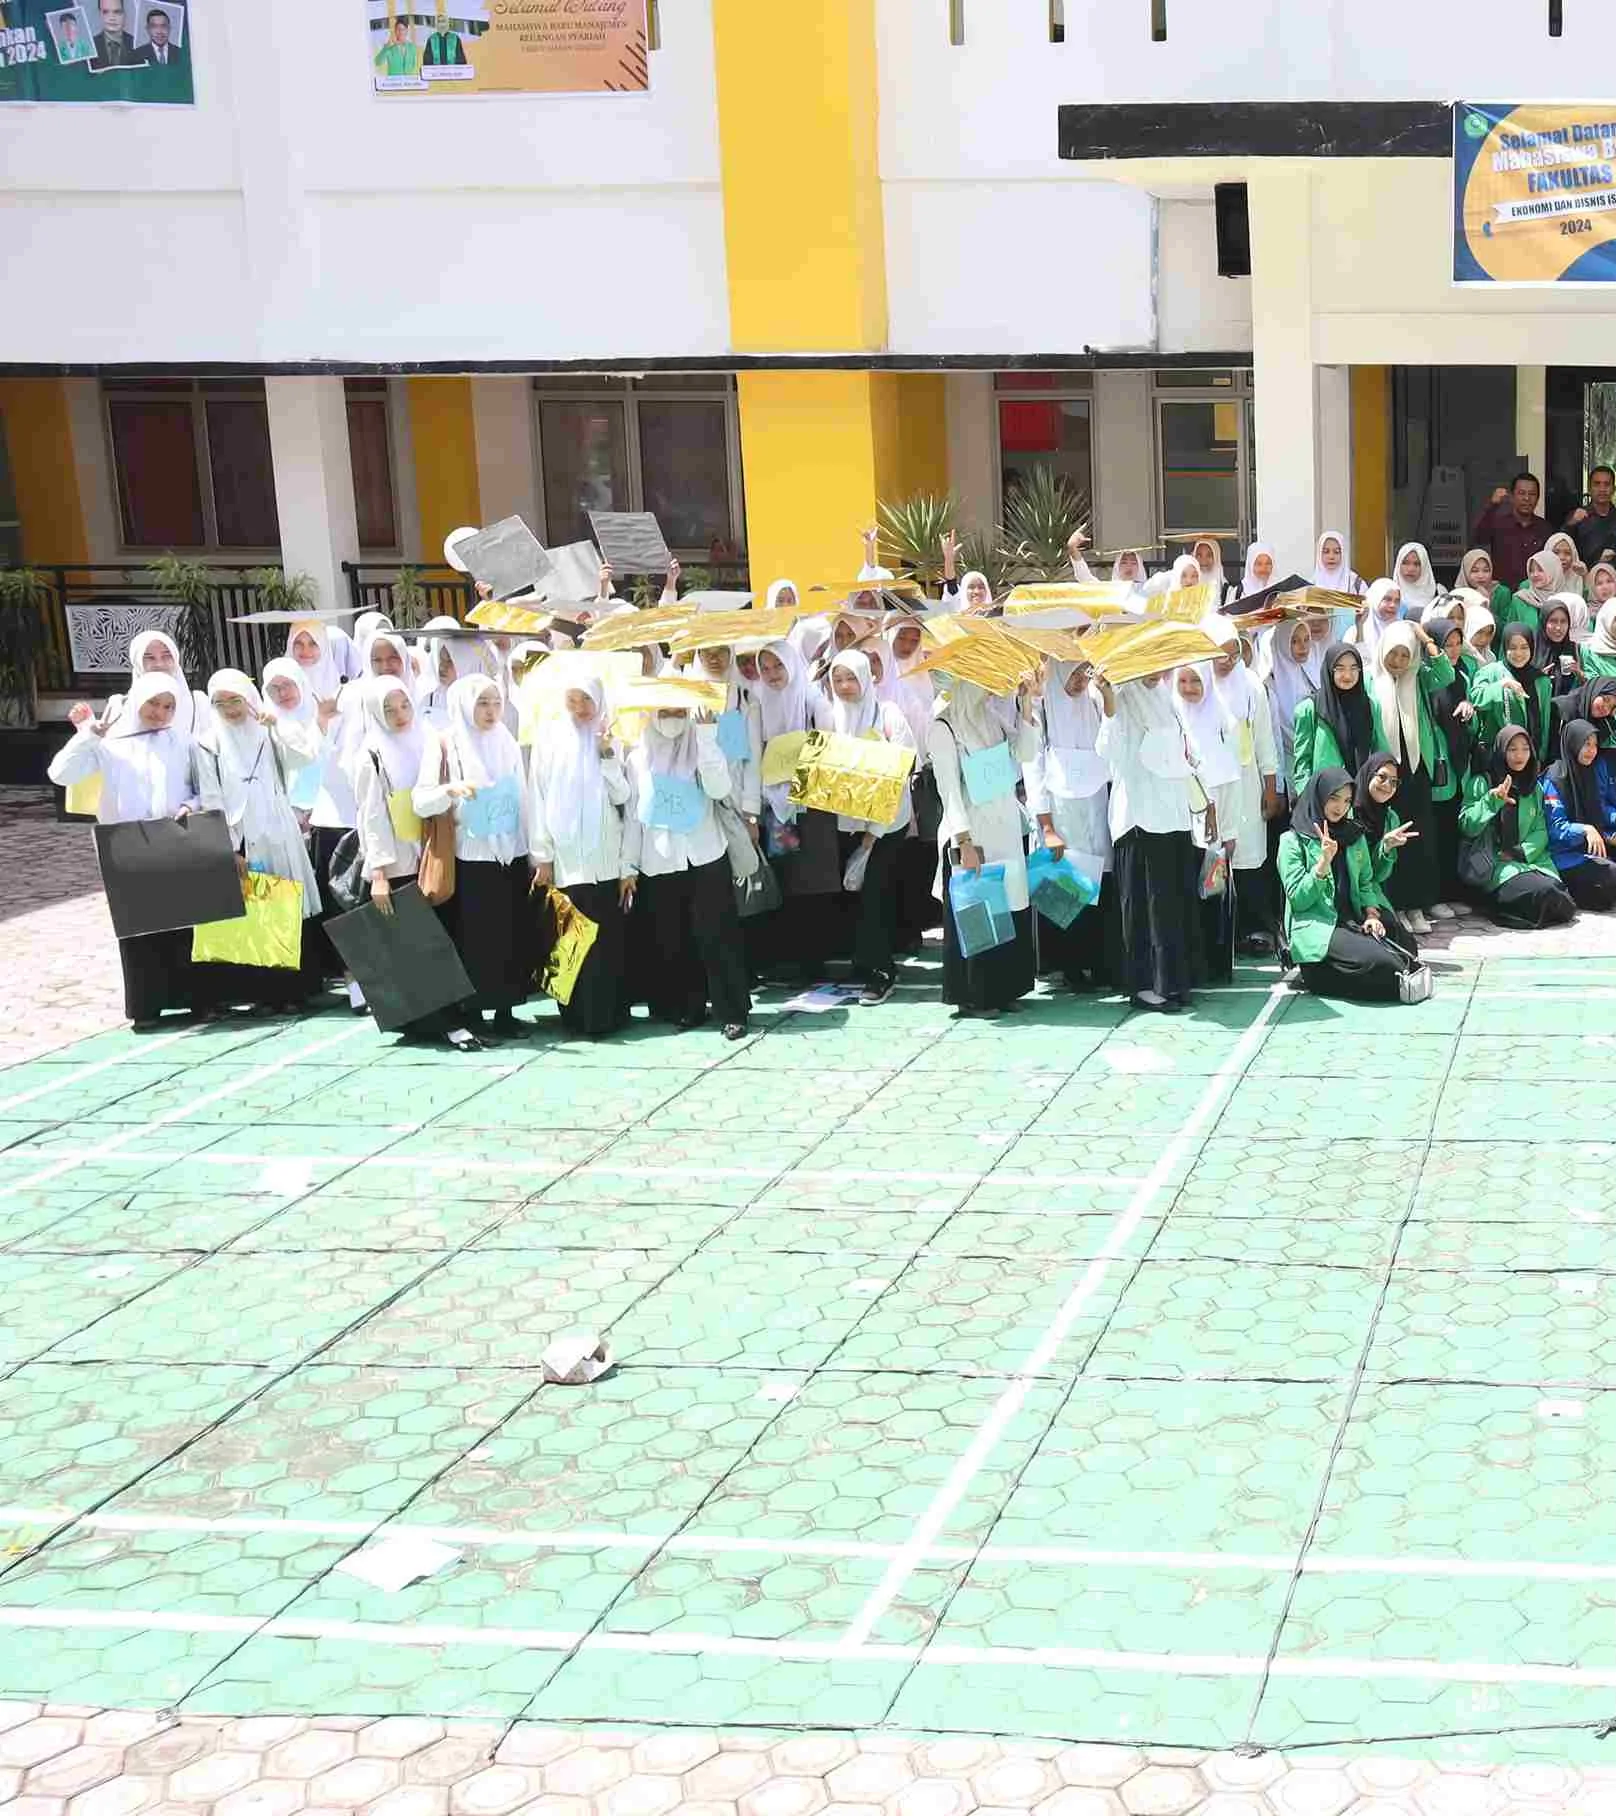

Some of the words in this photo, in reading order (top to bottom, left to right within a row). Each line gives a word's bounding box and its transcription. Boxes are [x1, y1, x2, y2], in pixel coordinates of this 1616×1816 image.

[1500, 128, 1569, 150] Selamat
[1527, 163, 1614, 194] FAKULTAS
[1511, 203, 1553, 218] EKONOMI
[1554, 199, 1574, 213] DAN
[1559, 218, 1593, 236] 2024
